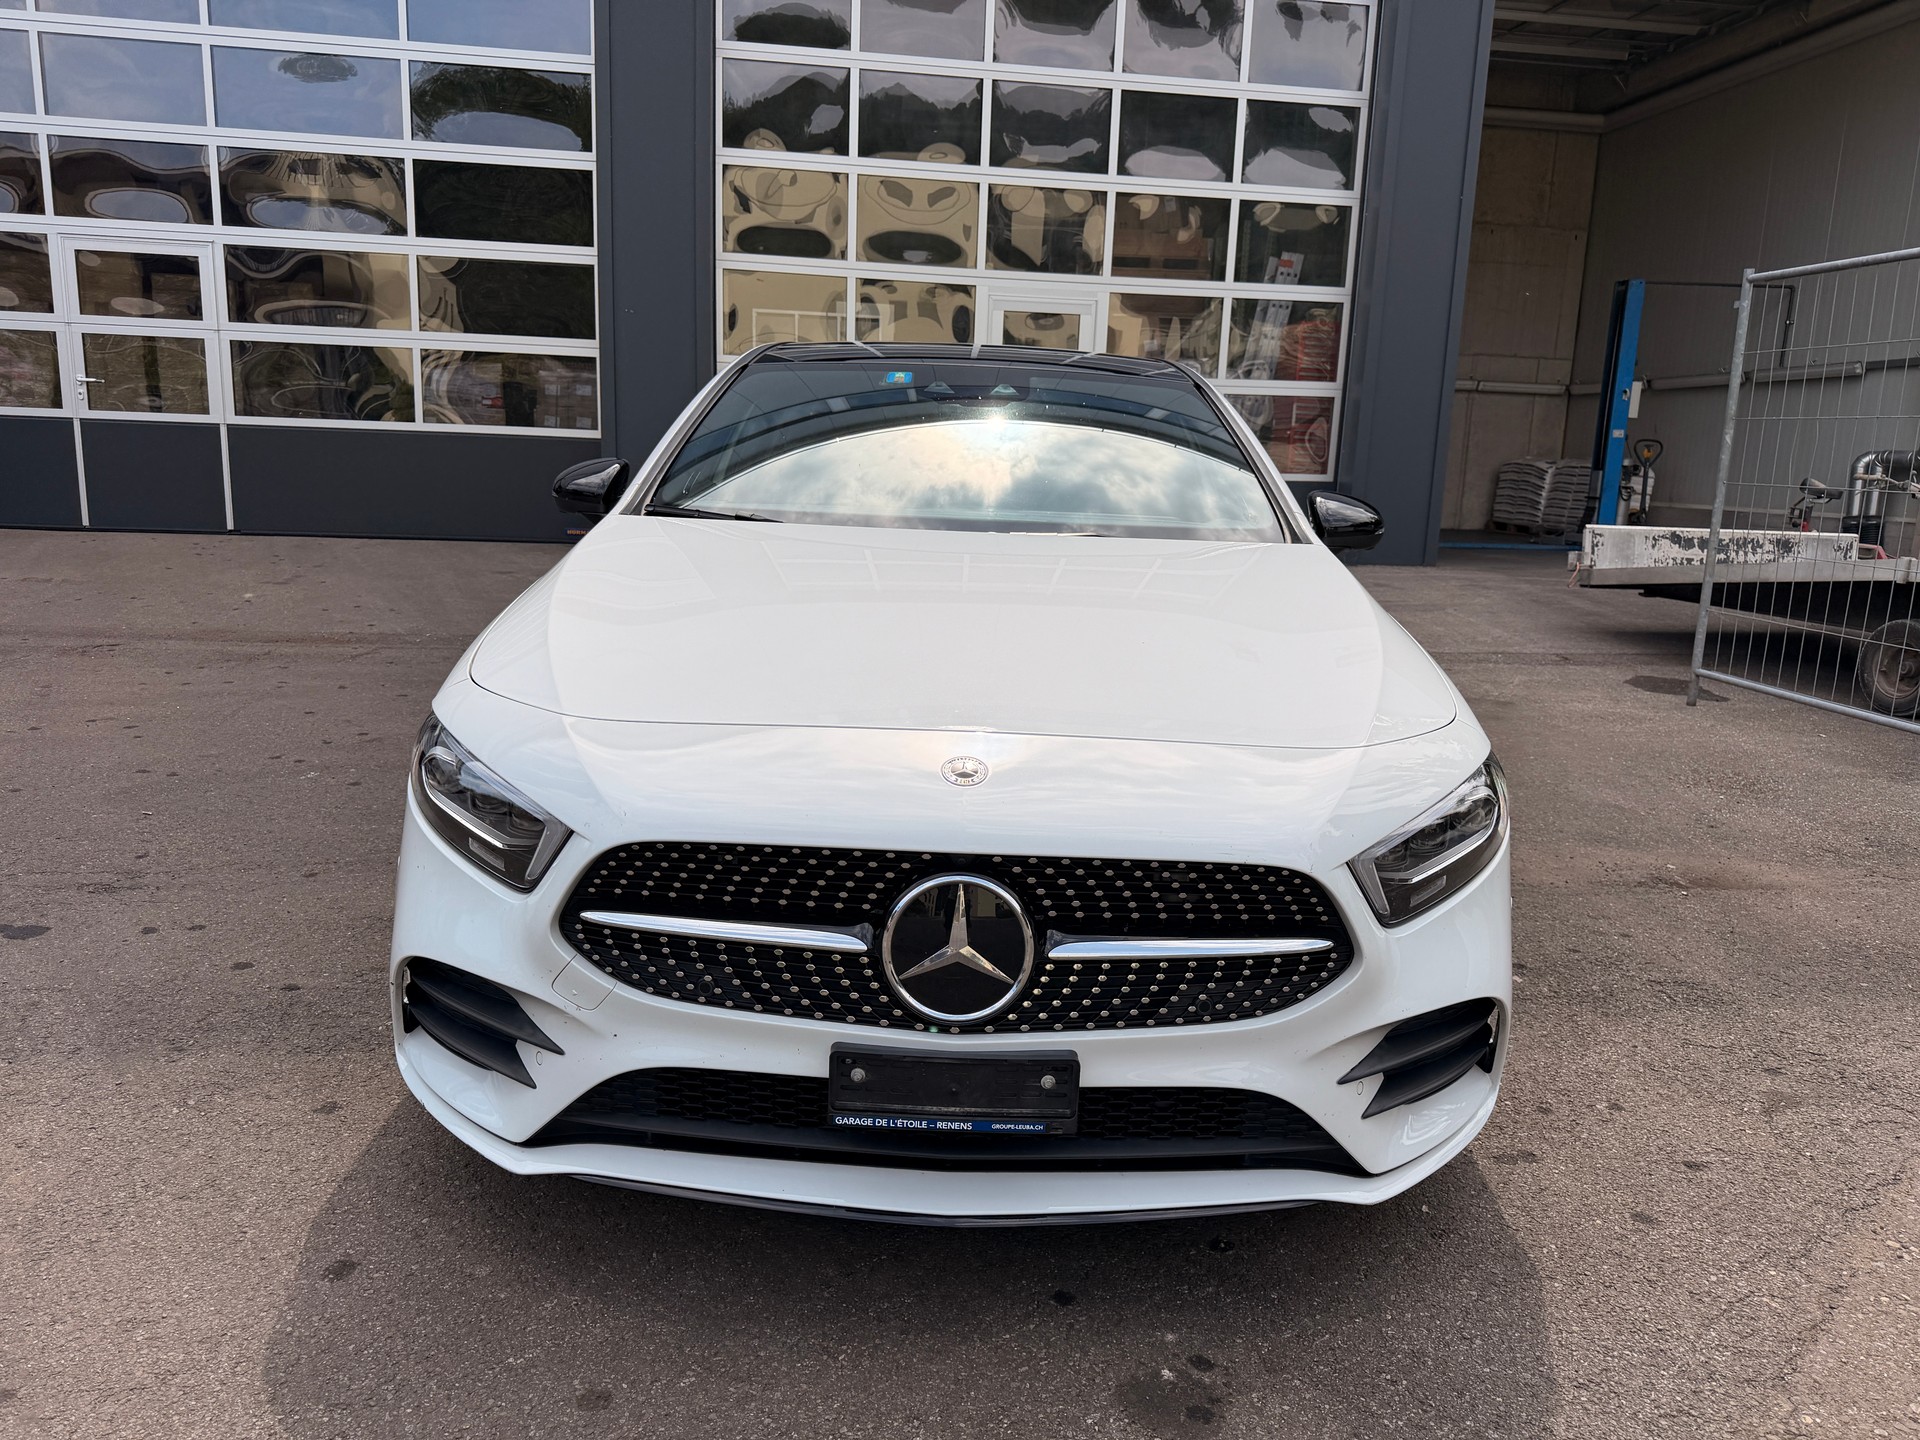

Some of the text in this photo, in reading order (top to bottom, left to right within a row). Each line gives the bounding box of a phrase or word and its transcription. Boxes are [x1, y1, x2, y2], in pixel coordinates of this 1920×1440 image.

[835, 1116, 873, 1126] GARAGE
[875, 1118, 888, 1127] DE
[890, 1118, 928, 1129] L'ÉTOILE
[936, 1121, 973, 1130] RENENS
[991, 1123, 1044, 1131] GROUPE-LEUBA.CH
